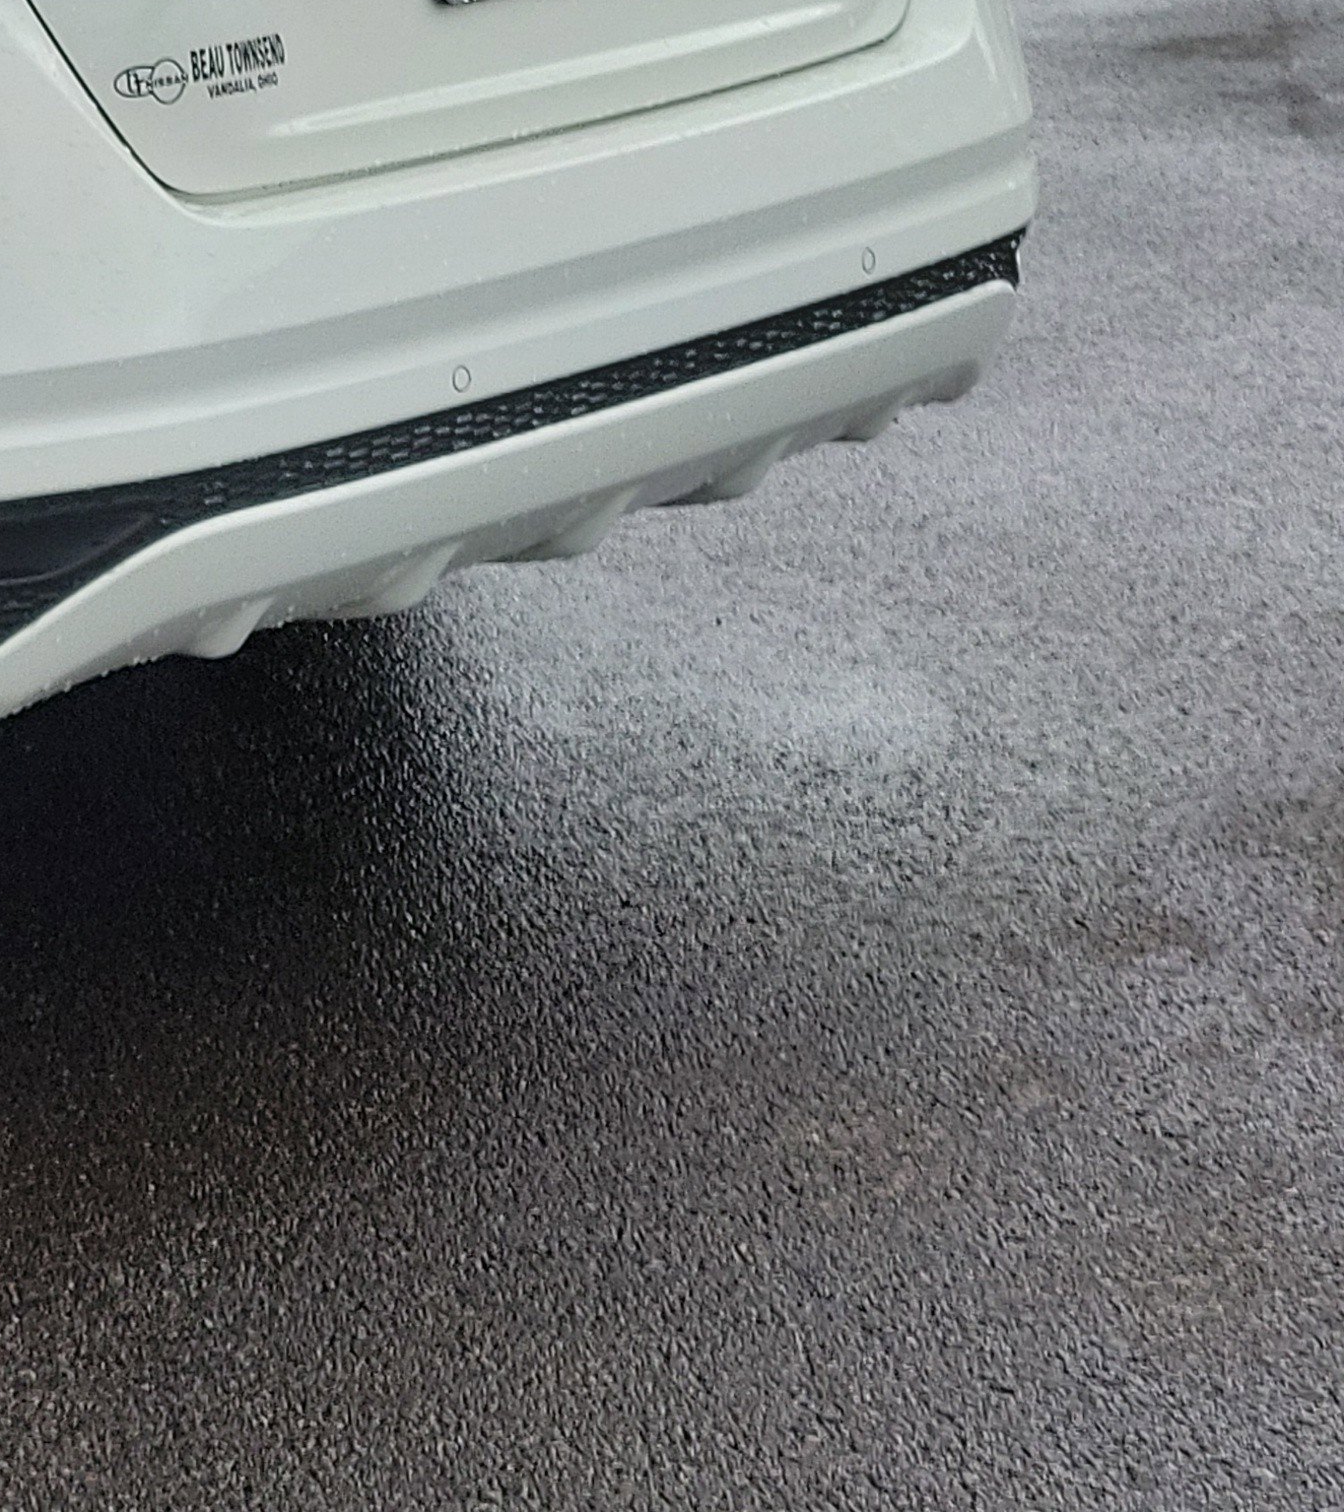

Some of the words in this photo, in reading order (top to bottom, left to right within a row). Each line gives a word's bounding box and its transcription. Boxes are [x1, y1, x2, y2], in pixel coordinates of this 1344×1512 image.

[190, 45, 226, 82] BEAU
[225, 33, 286, 74] TOWNSEND
[207, 79, 258, 99] VANDALIA,
[257, 72, 279, 90] OHIO
